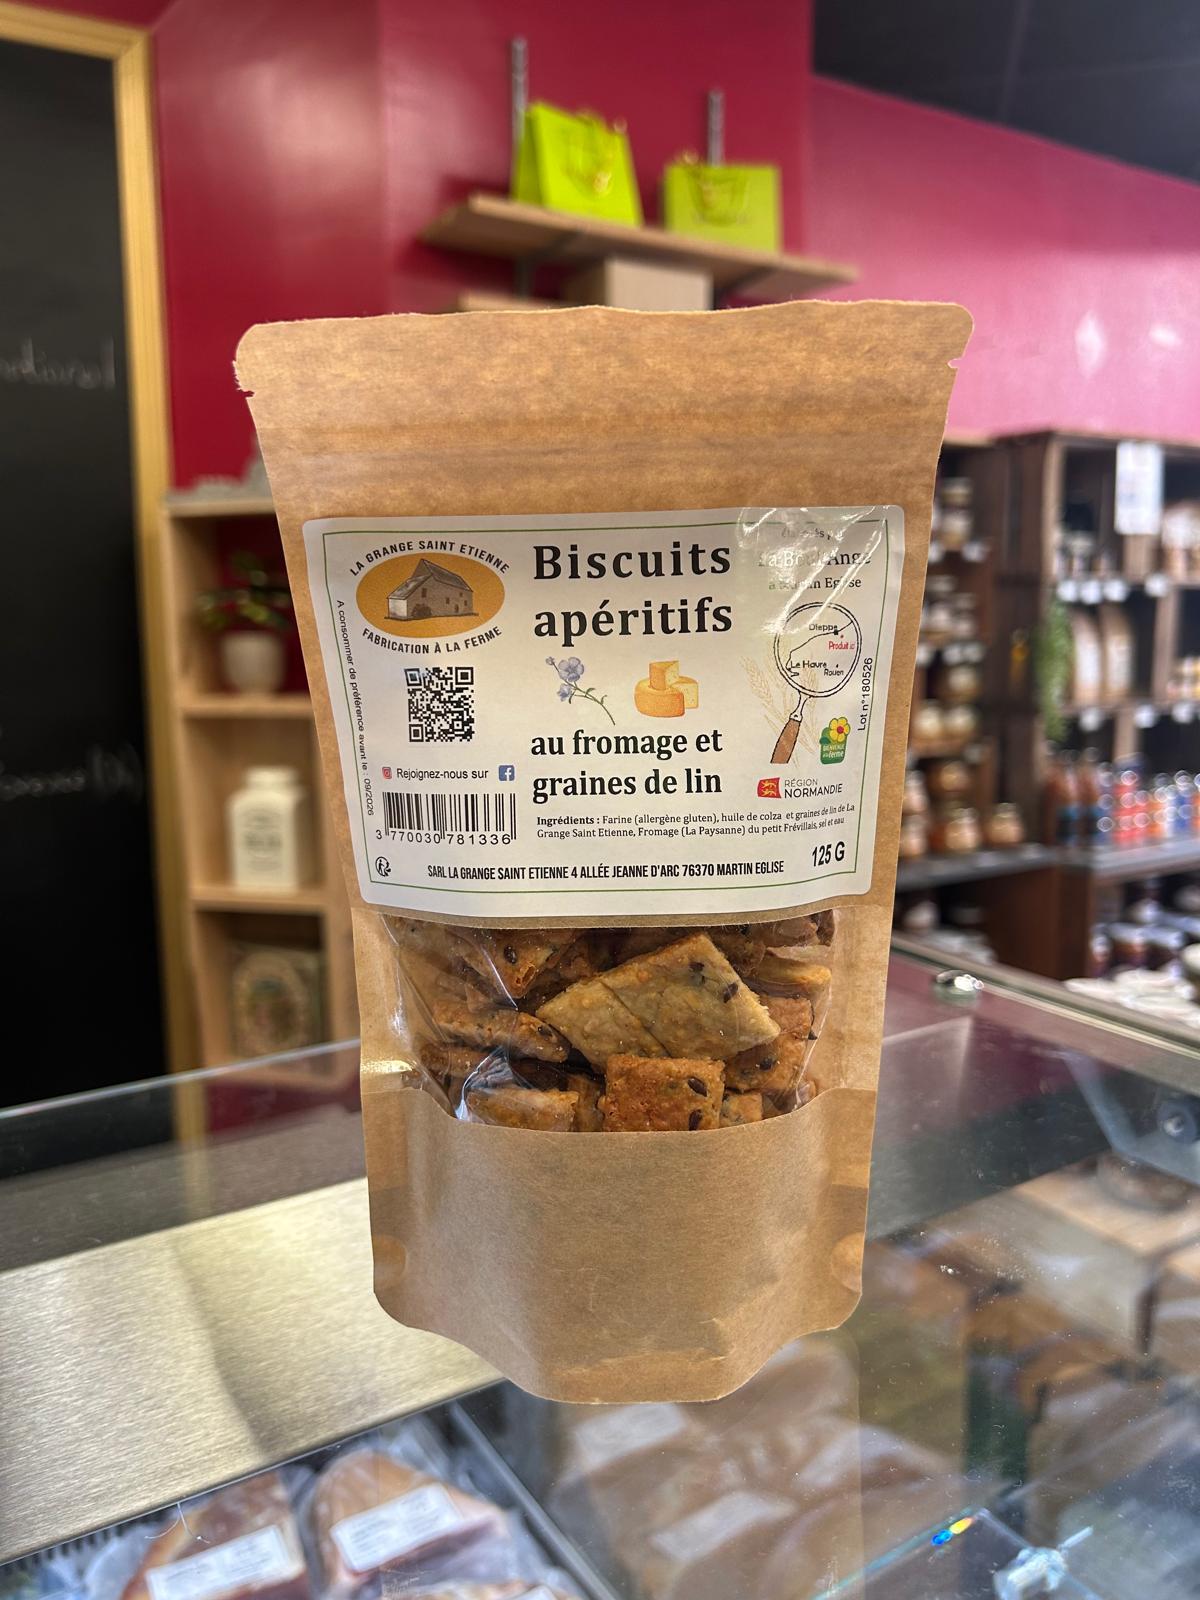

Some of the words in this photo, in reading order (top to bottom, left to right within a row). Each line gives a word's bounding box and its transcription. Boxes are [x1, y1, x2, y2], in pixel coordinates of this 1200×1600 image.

[350, 561, 364, 576] LA
[366, 541, 414, 563] GRANGE
[419, 541, 455, 550] SAINT
[460, 544, 510, 574] ETIENNE
[533, 541, 731, 580] Biscuits
[337, 600, 344, 608] A
[534, 597, 732, 647] apéritifs
[338, 610, 353, 665] consommer
[362, 628, 429, 654] FABRICATION
[434, 642, 442, 654] À
[446, 640, 461, 652] LA
[464, 626, 502, 649] FERME
[349, 668, 356, 680] de
[349, 682, 364, 732] préférence
[858, 712, 868, 731] Lot
[358, 734, 367, 760] avant
[531, 736, 565, 756] au
[573, 729, 688, 761] fromage
[695, 729, 723, 752] et
[361, 762, 368, 771] le
[396, 768, 469, 781] Rejoignez-nous
[472, 769, 489, 779] sur
[533, 771, 637, 805] graines
[644, 769, 678, 795] de
[685, 768, 722, 794] lin
[784, 783, 843, 798] NORMANDIE
[785, 778, 818, 787] RÉGION
[364, 778, 374, 816] 09/2026
[536, 816, 595, 827] Ingrédients
[602, 815, 632, 824] Farine
[634, 814, 681, 826] (allergène
[683, 812, 719, 825] gluten),
[721, 812, 745, 822] huile
[746, 812, 757, 821] de
[759, 811, 782, 821] colza
[786, 812, 794, 820] et
[795, 808, 820, 821] graines
[821, 807, 829, 816] de
[829, 805, 837, 814] lin
[838, 804, 845, 813] de
[846, 803, 855, 812] La
[376, 830, 382, 840] 3
[390, 831, 441, 844] 770030
[446, 834, 511, 845] 781336
[537, 829, 570, 840] Grange
[572, 828, 596, 838] Saint
[598, 828, 636, 838] Etienne,
[638, 827, 679, 838] Fromage
[681, 826, 696, 837] (La
[699, 825, 746, 837] Paysanne)
[748, 825, 759, 834] du
[762, 824, 782, 835] petit
[784, 821, 818, 832] Frévillais,
[819, 820, 827, 828] sel
[827, 819, 834, 827] et
[834, 817, 844, 825] eau
[812, 843, 832, 867] 125
[834, 841, 845, 862] G
[427, 864, 447, 878] SARL
[448, 866, 459, 879] LA
[460, 867, 496, 880] GRANGE
[497, 867, 526, 880] SAINT
[528, 866, 569, 879] ETIENNE
[571, 866, 578, 878] 4
[580, 863, 610, 879] ALLÉE
[611, 865, 648, 878] JEANNE
[650, 864, 680, 877] D'ARC
[682, 863, 714, 877] 76370
[716, 862, 753, 876] MARTIN
[755, 861, 784, 874] EGLISE
